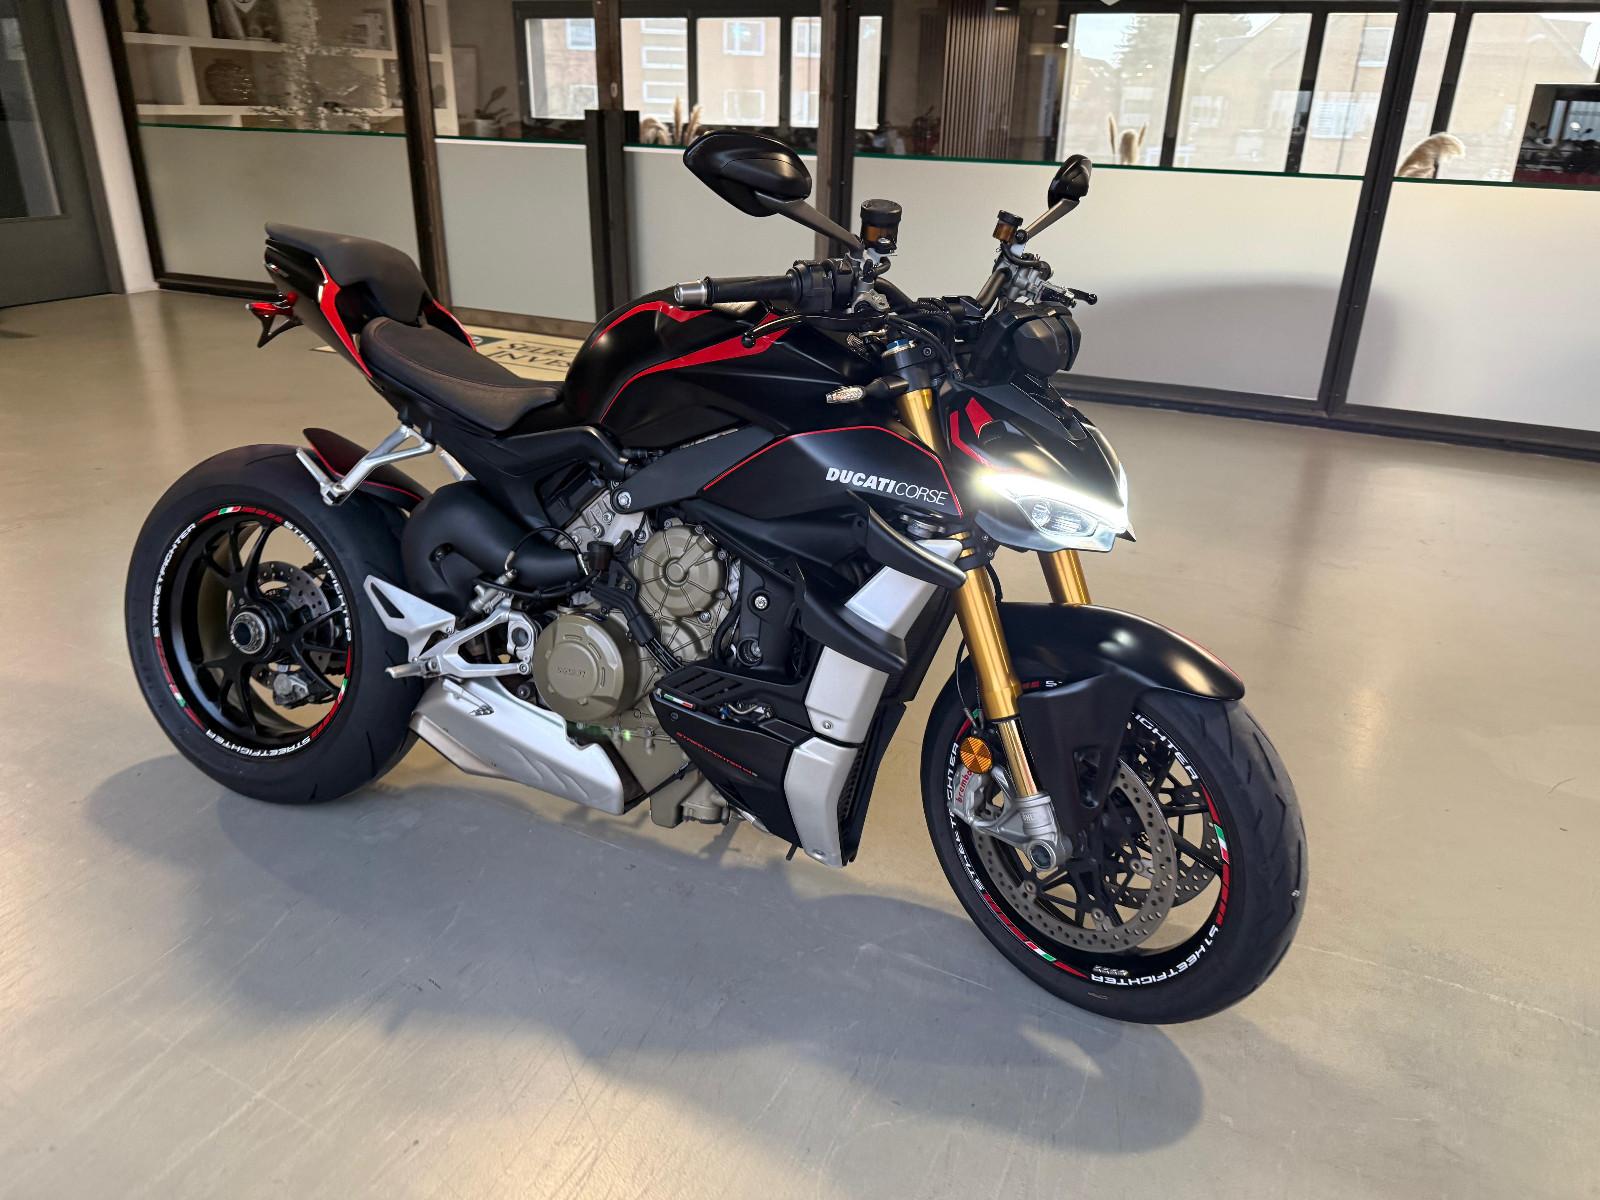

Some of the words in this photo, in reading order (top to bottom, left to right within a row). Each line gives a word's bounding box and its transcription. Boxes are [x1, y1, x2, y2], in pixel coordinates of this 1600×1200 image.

[826, 467, 896, 493] DUCATI
[895, 482, 948, 505] CORSE
[1131, 711, 1199, 780] IGHTER
